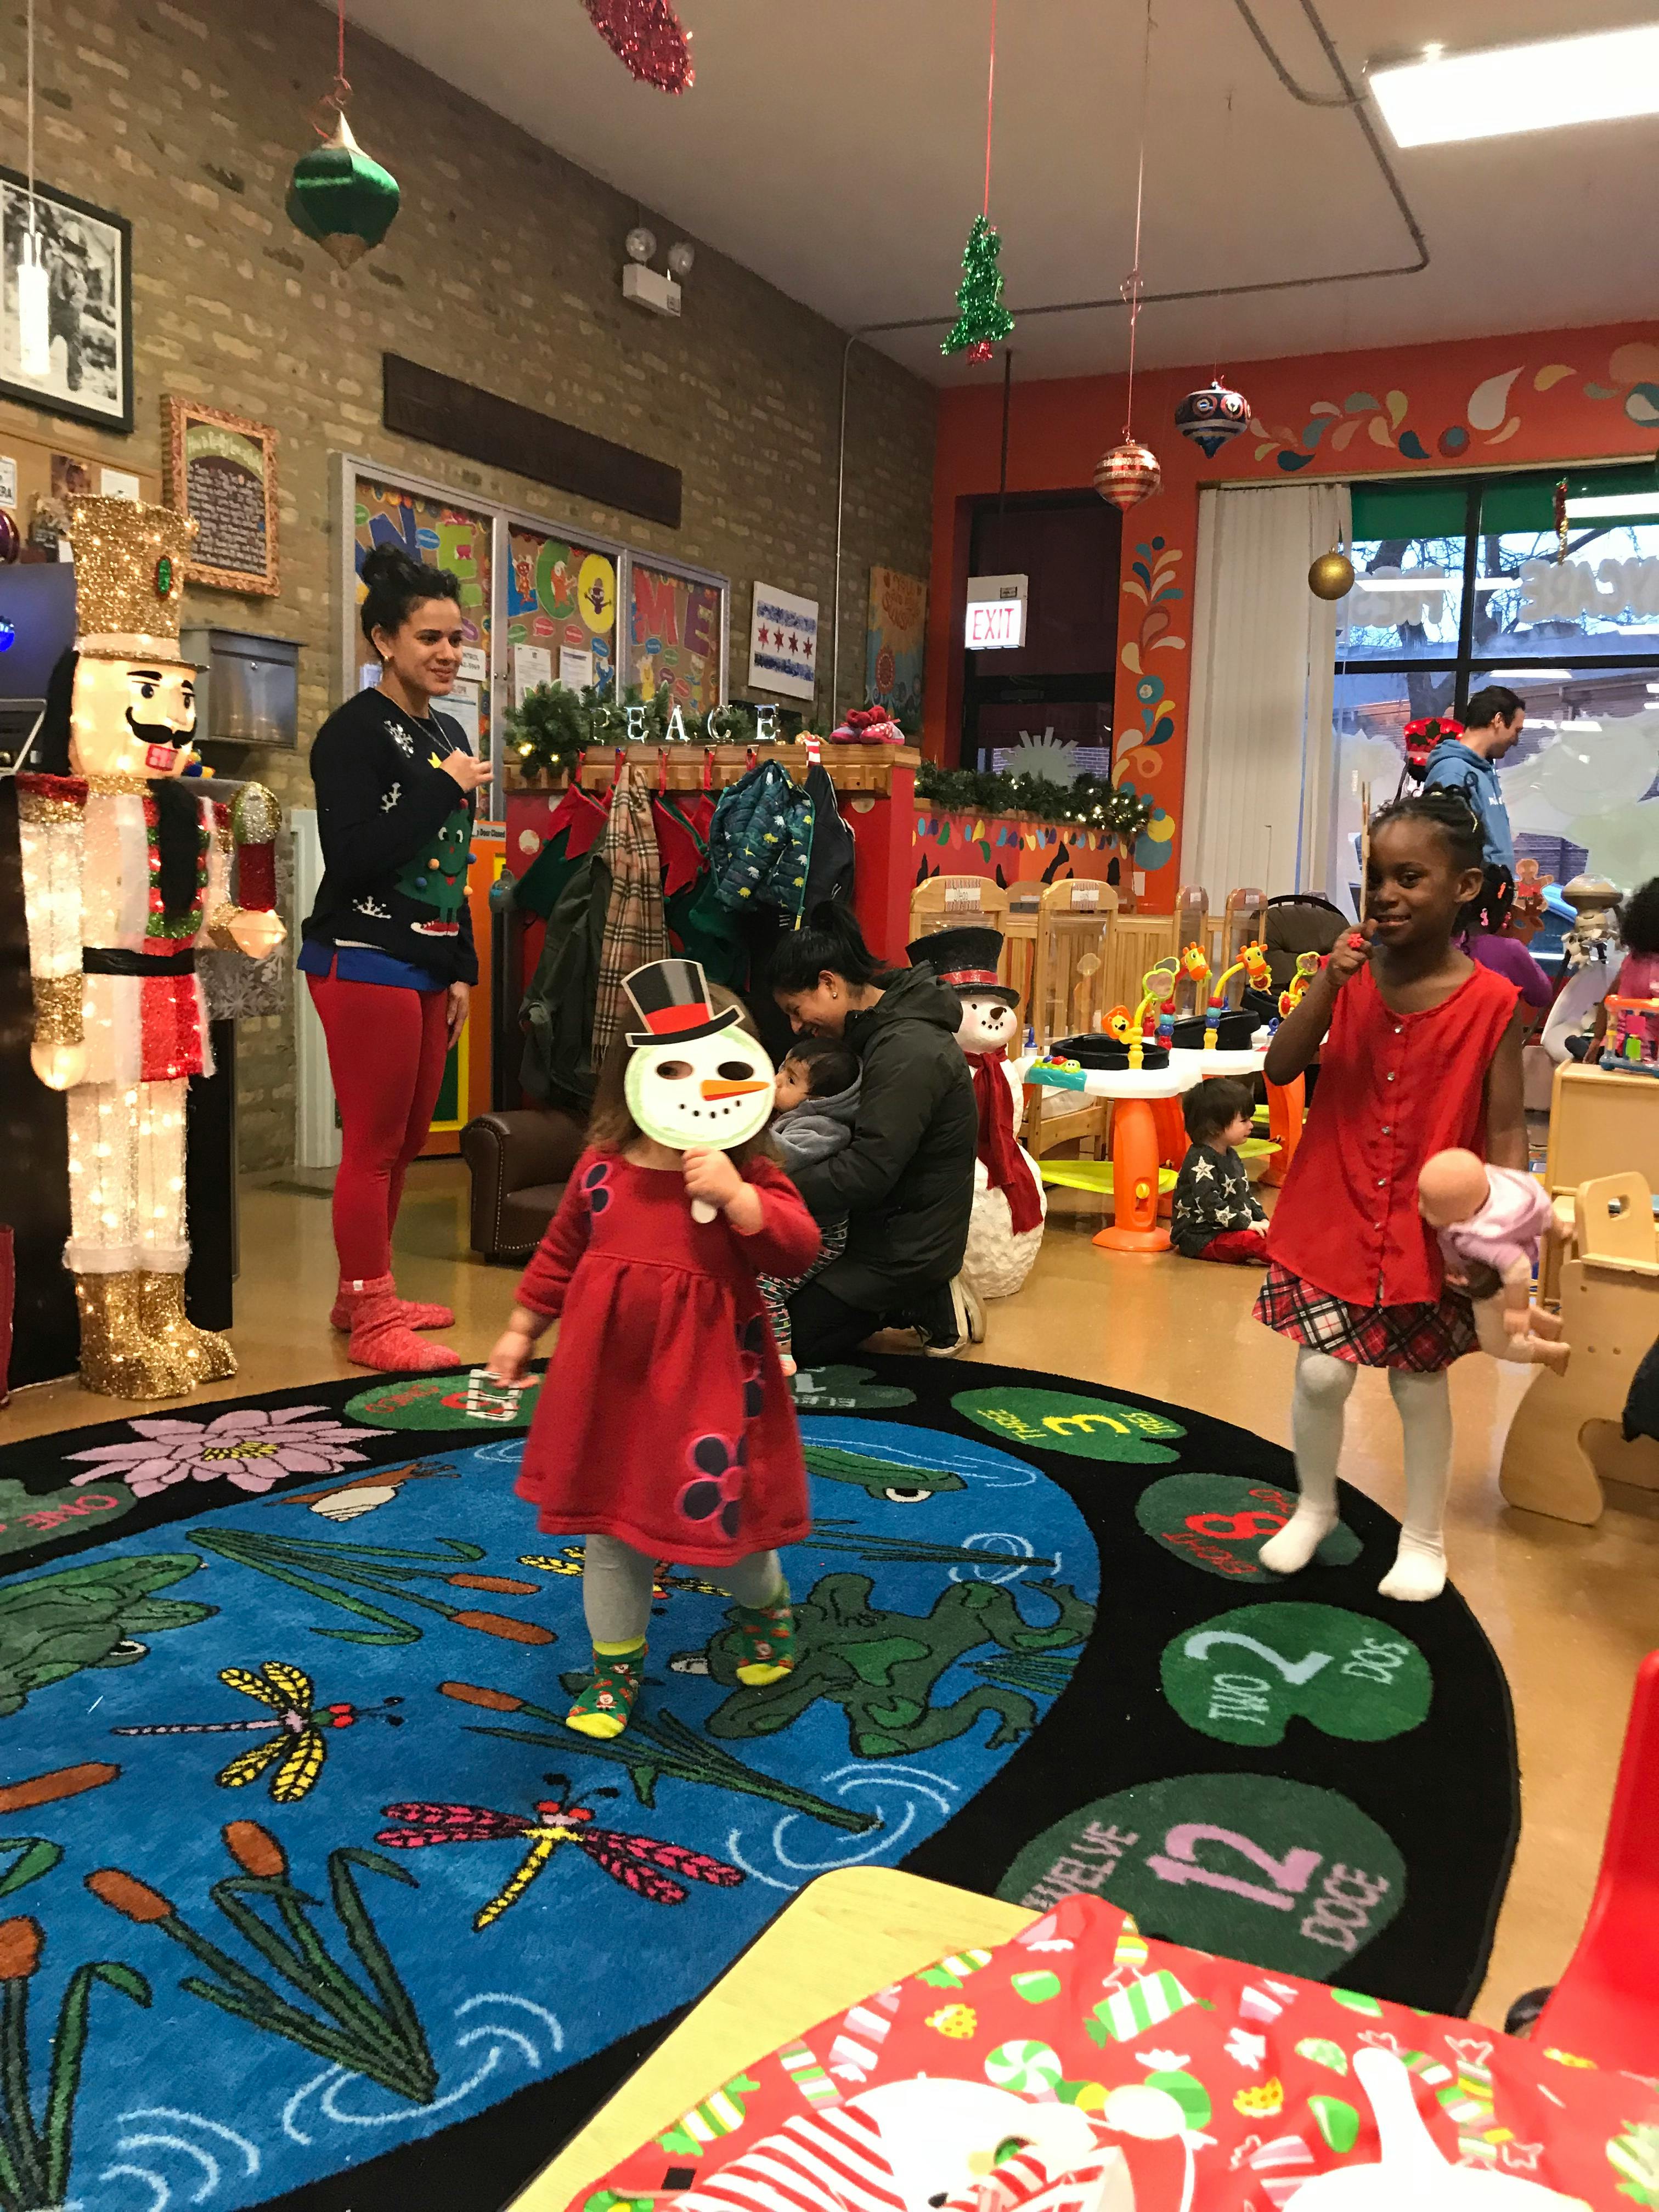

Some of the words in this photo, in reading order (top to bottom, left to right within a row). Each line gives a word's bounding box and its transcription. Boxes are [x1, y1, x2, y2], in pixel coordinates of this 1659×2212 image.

[973, 608, 1014, 640] EXIT
[590, 704, 780, 745] PEACE
[977, 1409, 1047, 1440] THREE
[1042, 1414, 1131, 1436] 3
[1119, 1412, 1177, 1435] TRES
[15, 1494, 119, 1531] ONE
[1185, 1511, 1290, 1540] 8
[1184, 1630, 1334, 1685] 2
[1341, 1638, 1410, 1685] DOS
[1208, 1672, 1271, 1725] TWO
[1147, 1822, 1323, 1912] 12
[1300, 1863, 1391, 1953] DOCE
